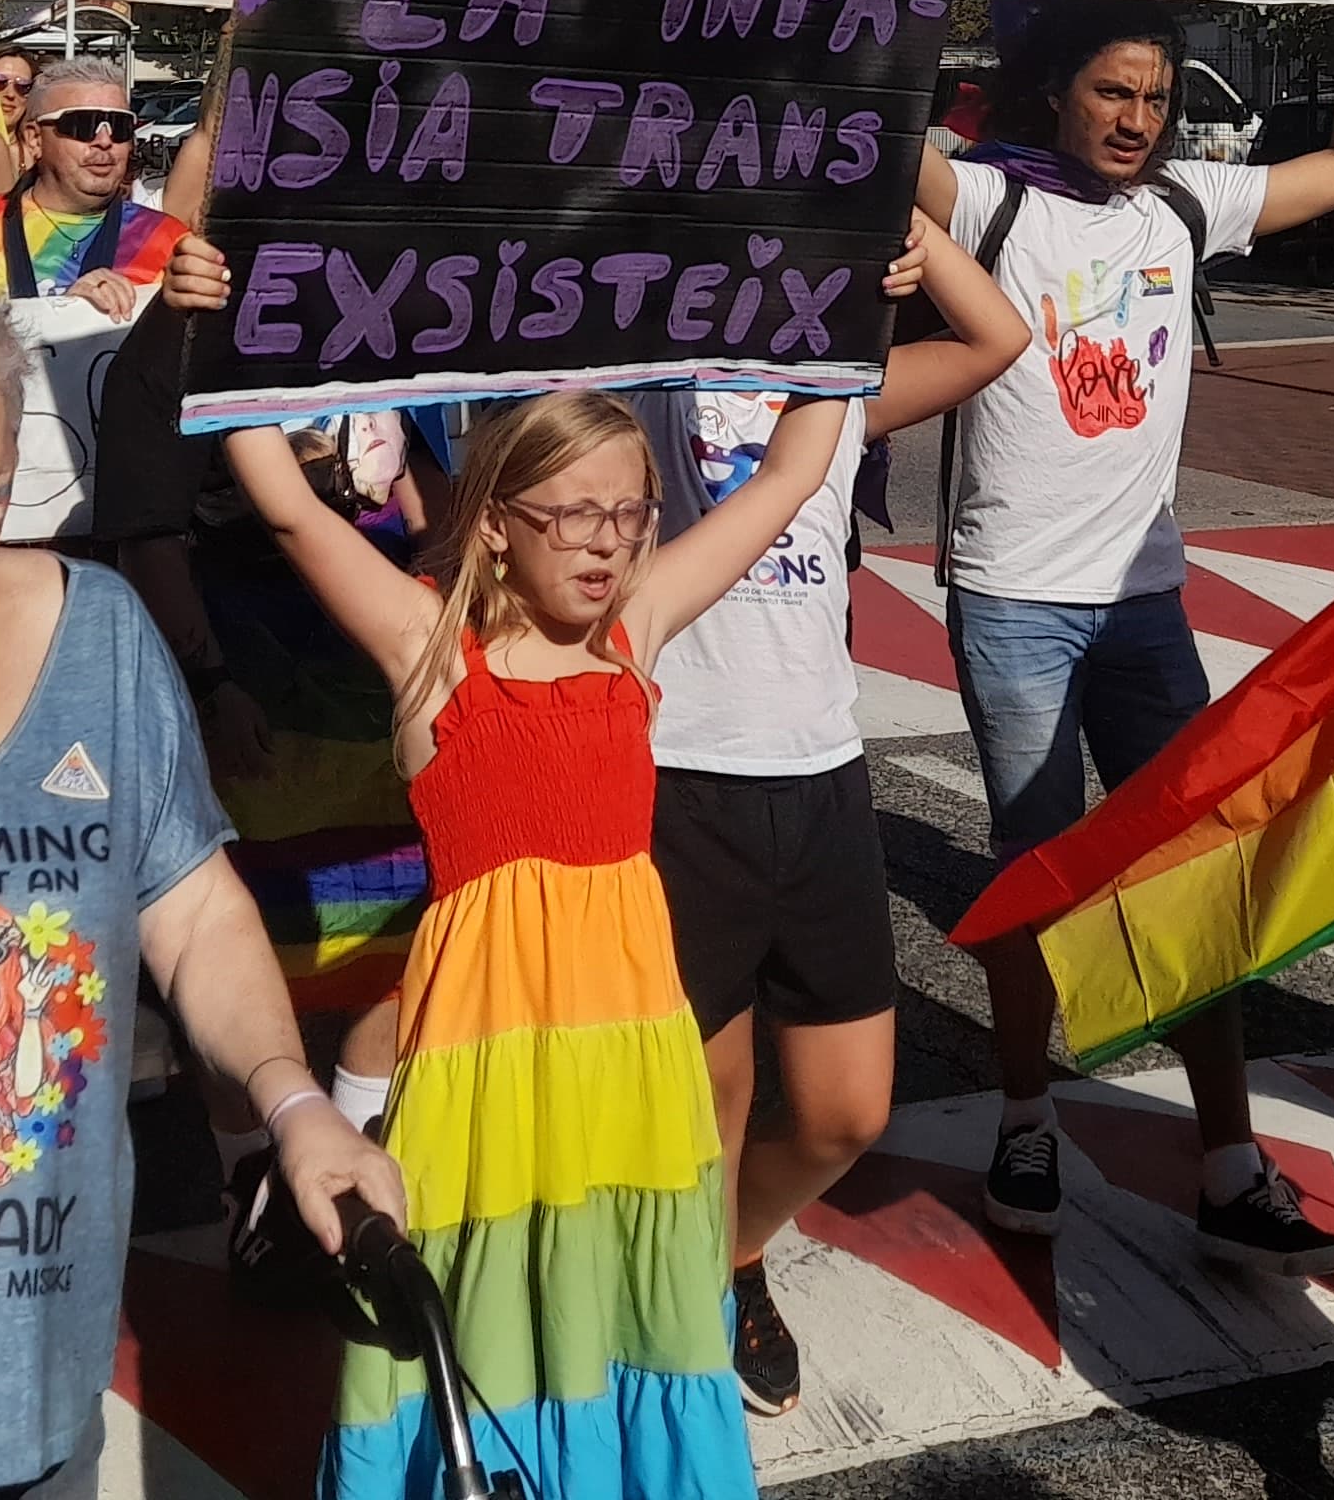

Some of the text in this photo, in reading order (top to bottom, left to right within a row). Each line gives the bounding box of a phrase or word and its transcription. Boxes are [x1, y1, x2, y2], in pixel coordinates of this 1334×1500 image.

[530, 77, 882, 191] TRANS
[1079, 403, 1140, 425] WINS
[27, 867, 80, 894] AN
